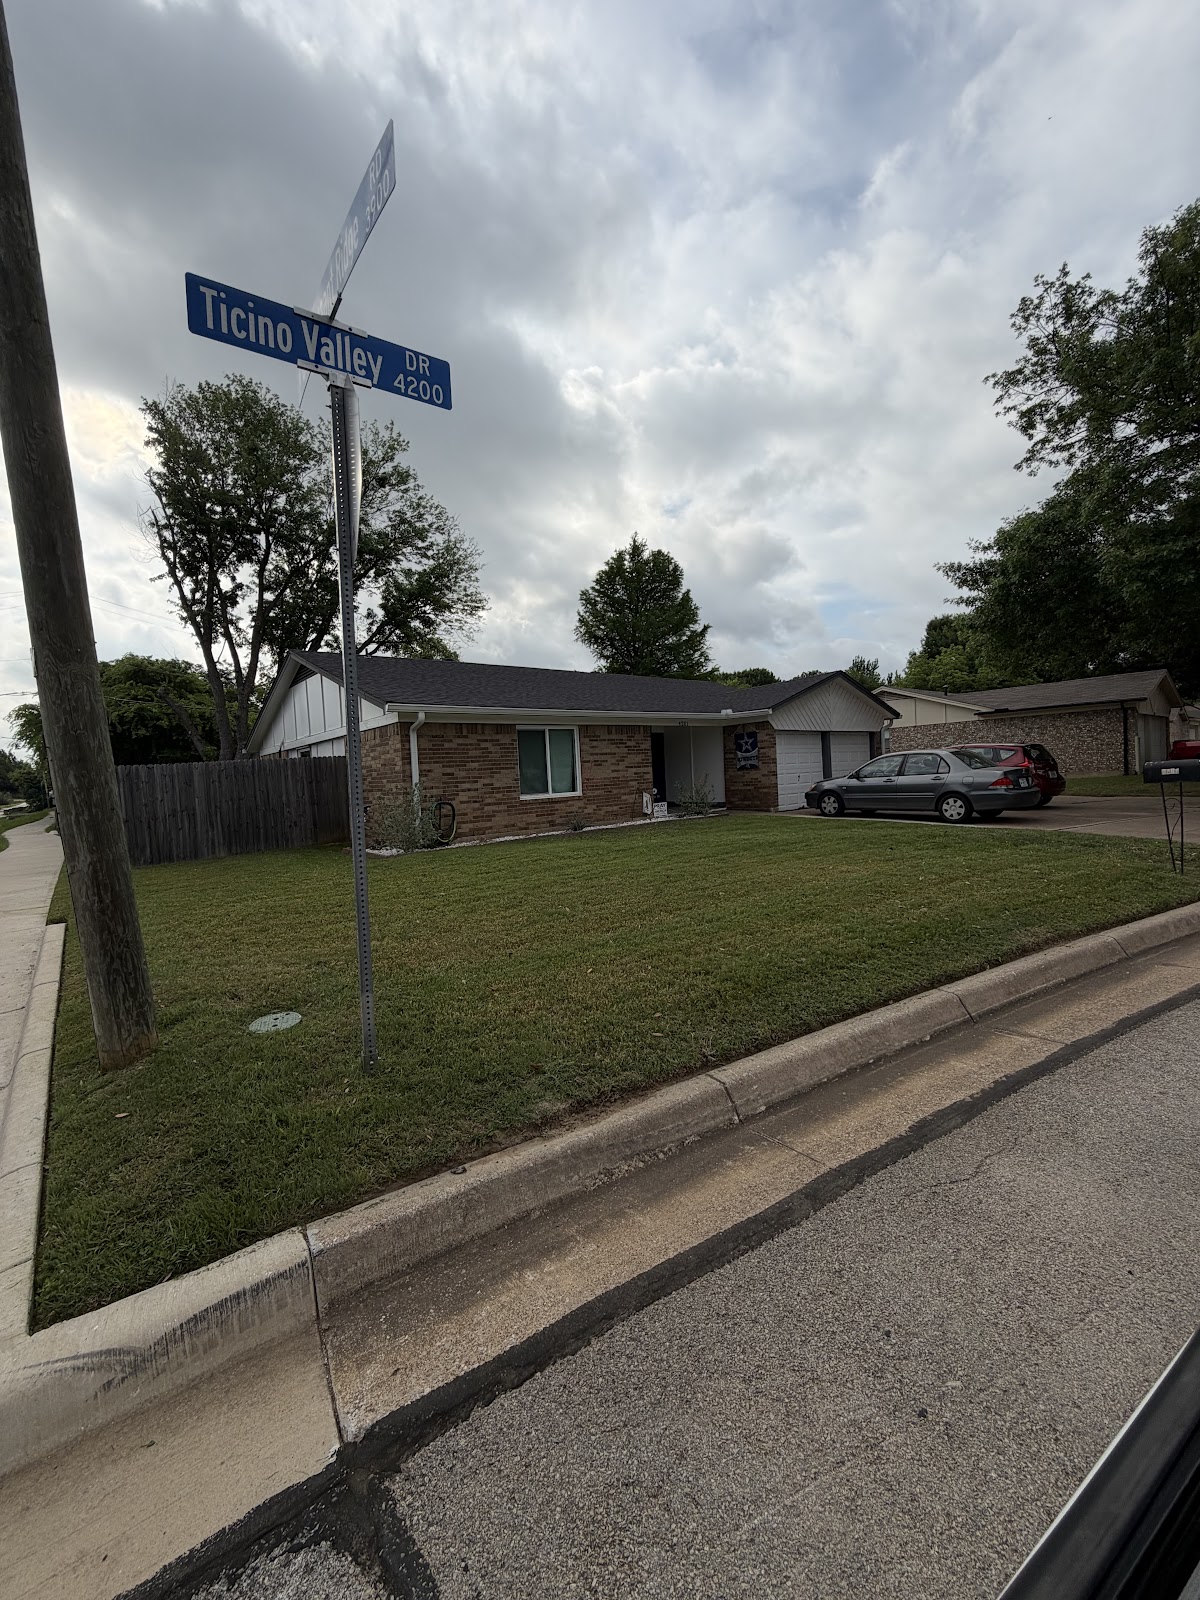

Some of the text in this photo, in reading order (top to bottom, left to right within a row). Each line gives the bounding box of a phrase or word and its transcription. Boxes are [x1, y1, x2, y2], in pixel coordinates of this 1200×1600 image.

[369, 148, 382, 191] RD
[365, 169, 390, 233] 3900
[335, 215, 359, 289] Ridge
[199, 284, 383, 385] Ticino Valley
[393, 373, 444, 405] 4200
[405, 350, 431, 377] DR
